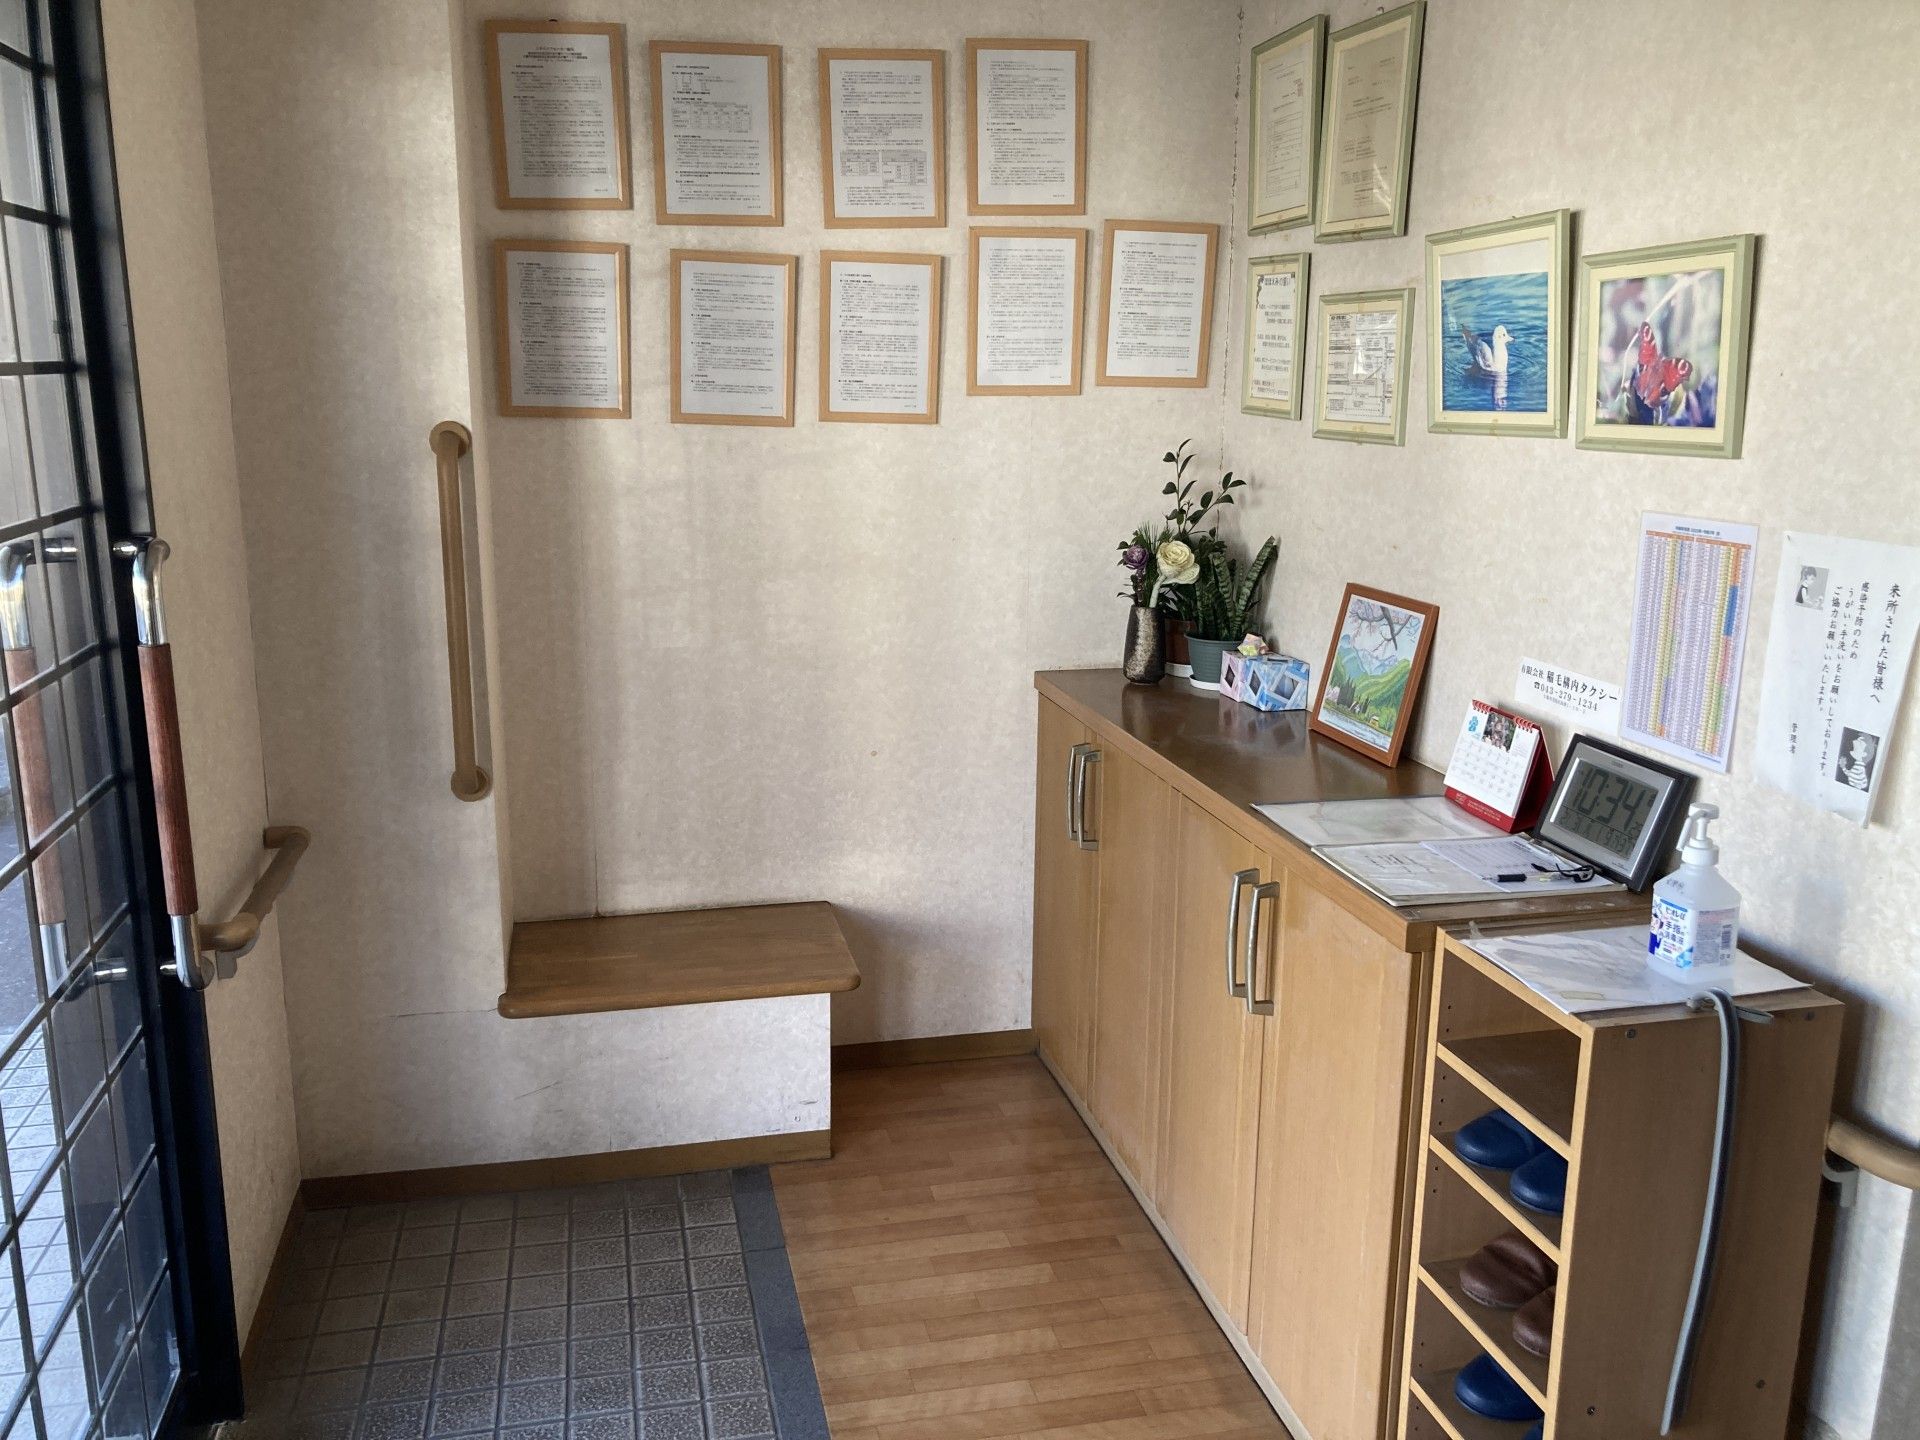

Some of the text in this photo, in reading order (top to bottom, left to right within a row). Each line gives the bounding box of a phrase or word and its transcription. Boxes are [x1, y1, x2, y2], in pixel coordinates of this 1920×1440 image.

[1849, 581, 1870, 660] 感染予防のため
[1870, 583, 1901, 704] 来所された皆様へ
[1521, 664, 1618, 701] 有限会社 稲毛構内タクシー
[1573, 768, 1646, 830] 10:34
